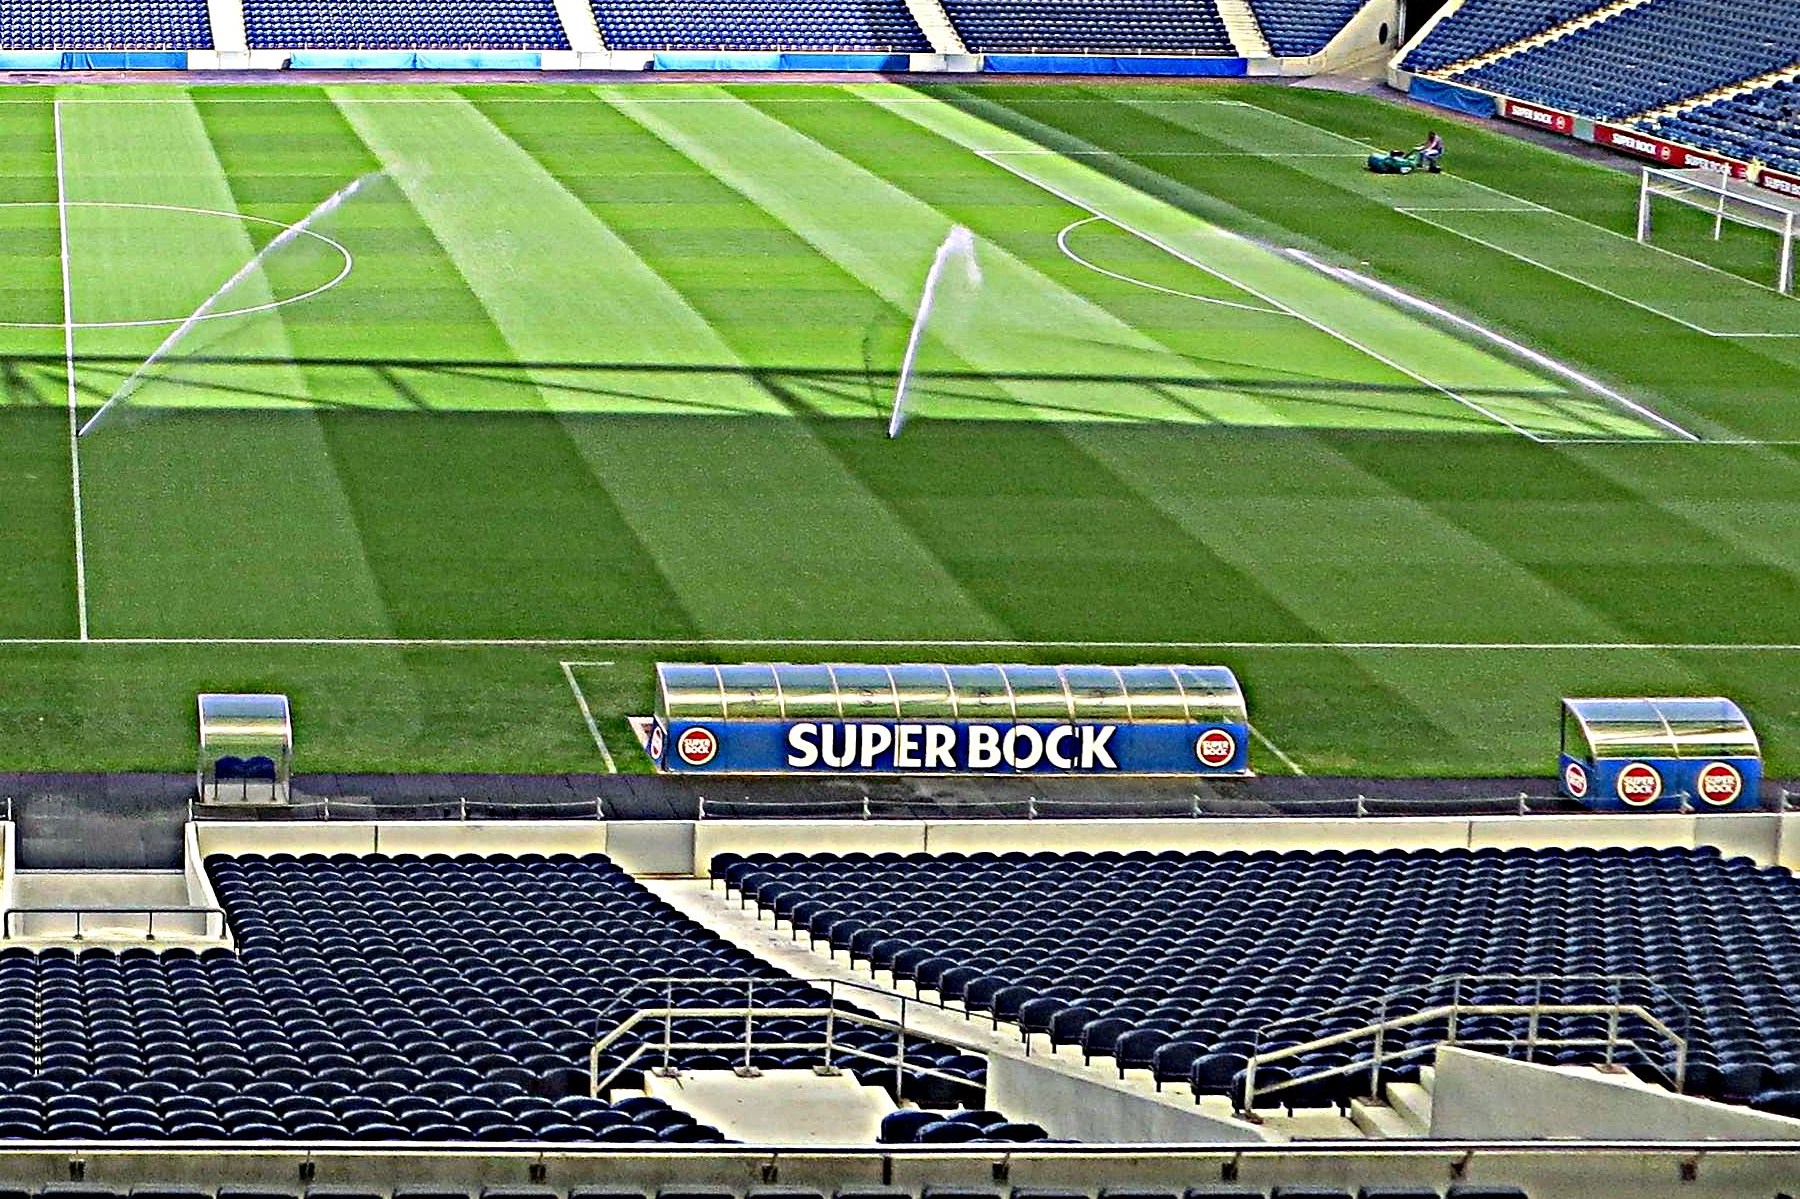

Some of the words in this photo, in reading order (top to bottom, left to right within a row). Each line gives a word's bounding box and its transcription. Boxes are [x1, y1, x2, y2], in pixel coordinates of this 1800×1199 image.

[684, 738, 710, 747] SUPER
[787, 722, 957, 768] SUPER
[968, 724, 1117, 769] BOCK
